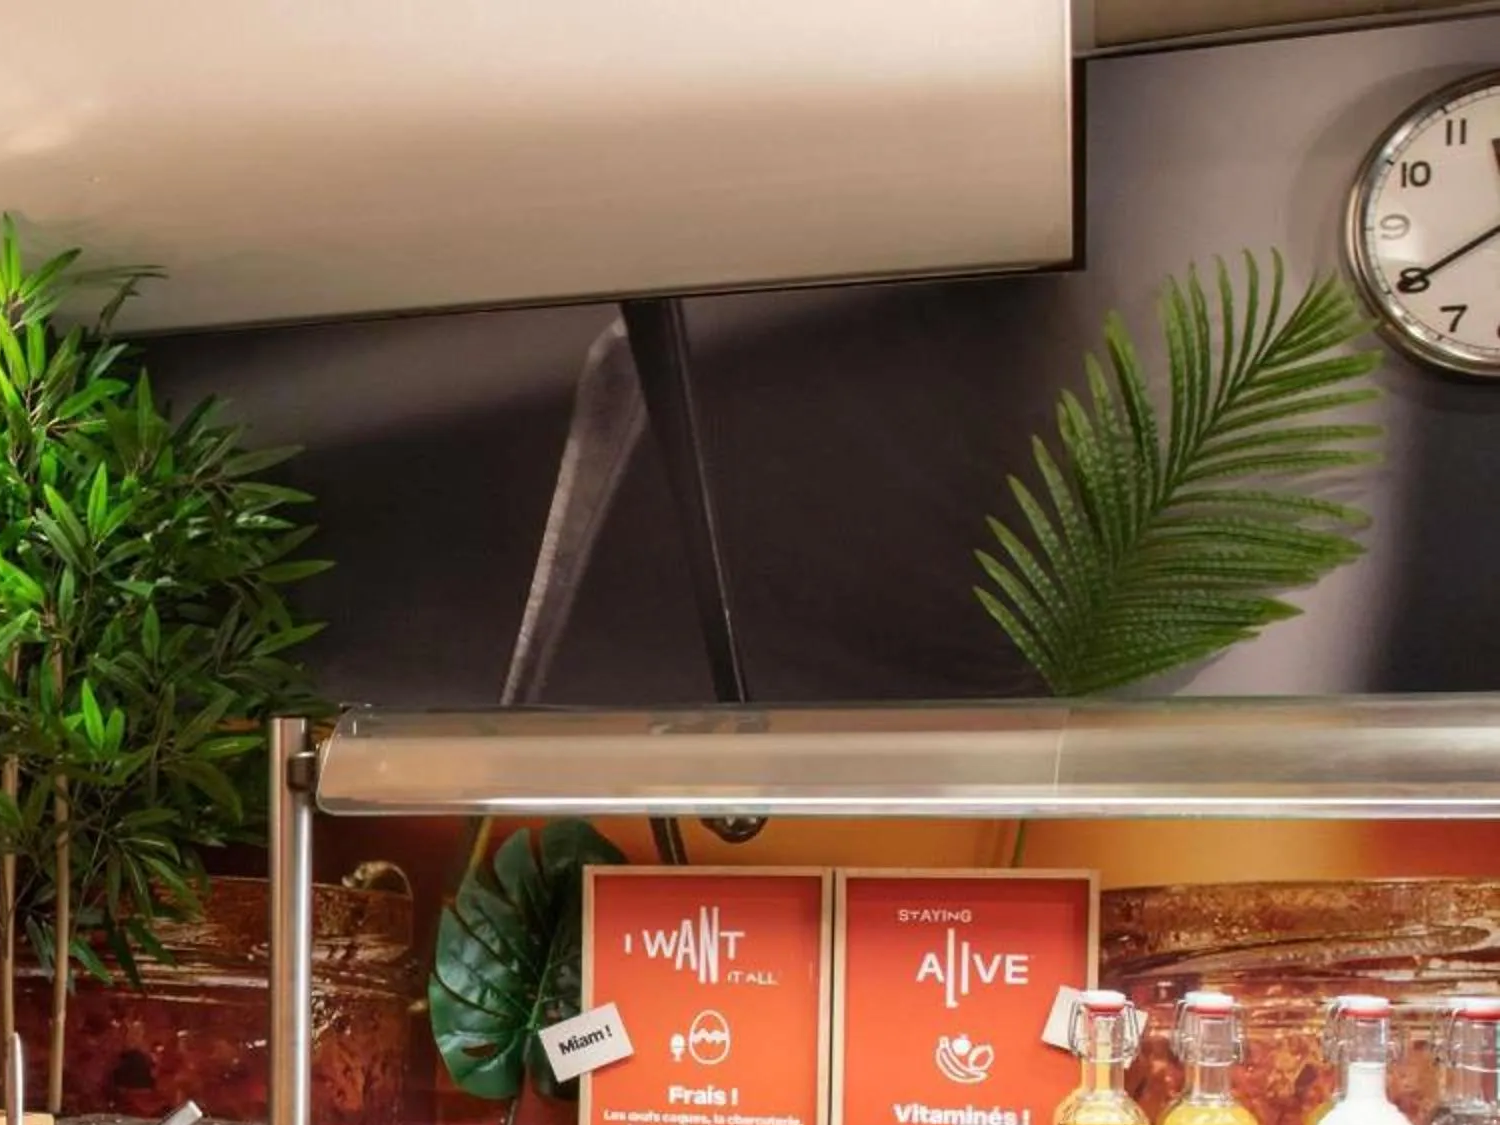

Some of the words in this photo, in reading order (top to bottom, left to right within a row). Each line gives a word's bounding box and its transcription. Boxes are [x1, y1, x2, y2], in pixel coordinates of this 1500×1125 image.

[1444, 117, 1467, 147] 11
[1400, 160, 1431, 188] 10
[1379, 213, 1411, 240] 9
[1439, 304, 1468, 332] 7
[898, 909, 973, 924] STAYING
[624, 933, 633, 955] I
[641, 905, 746, 985] WANT
[727, 970, 744, 984] IT
[745, 971, 779, 985] ALL
[915, 927, 1029, 1008] ALIVE
[558, 1028, 604, 1055] Miam
[668, 1085, 727, 1106] Frais
